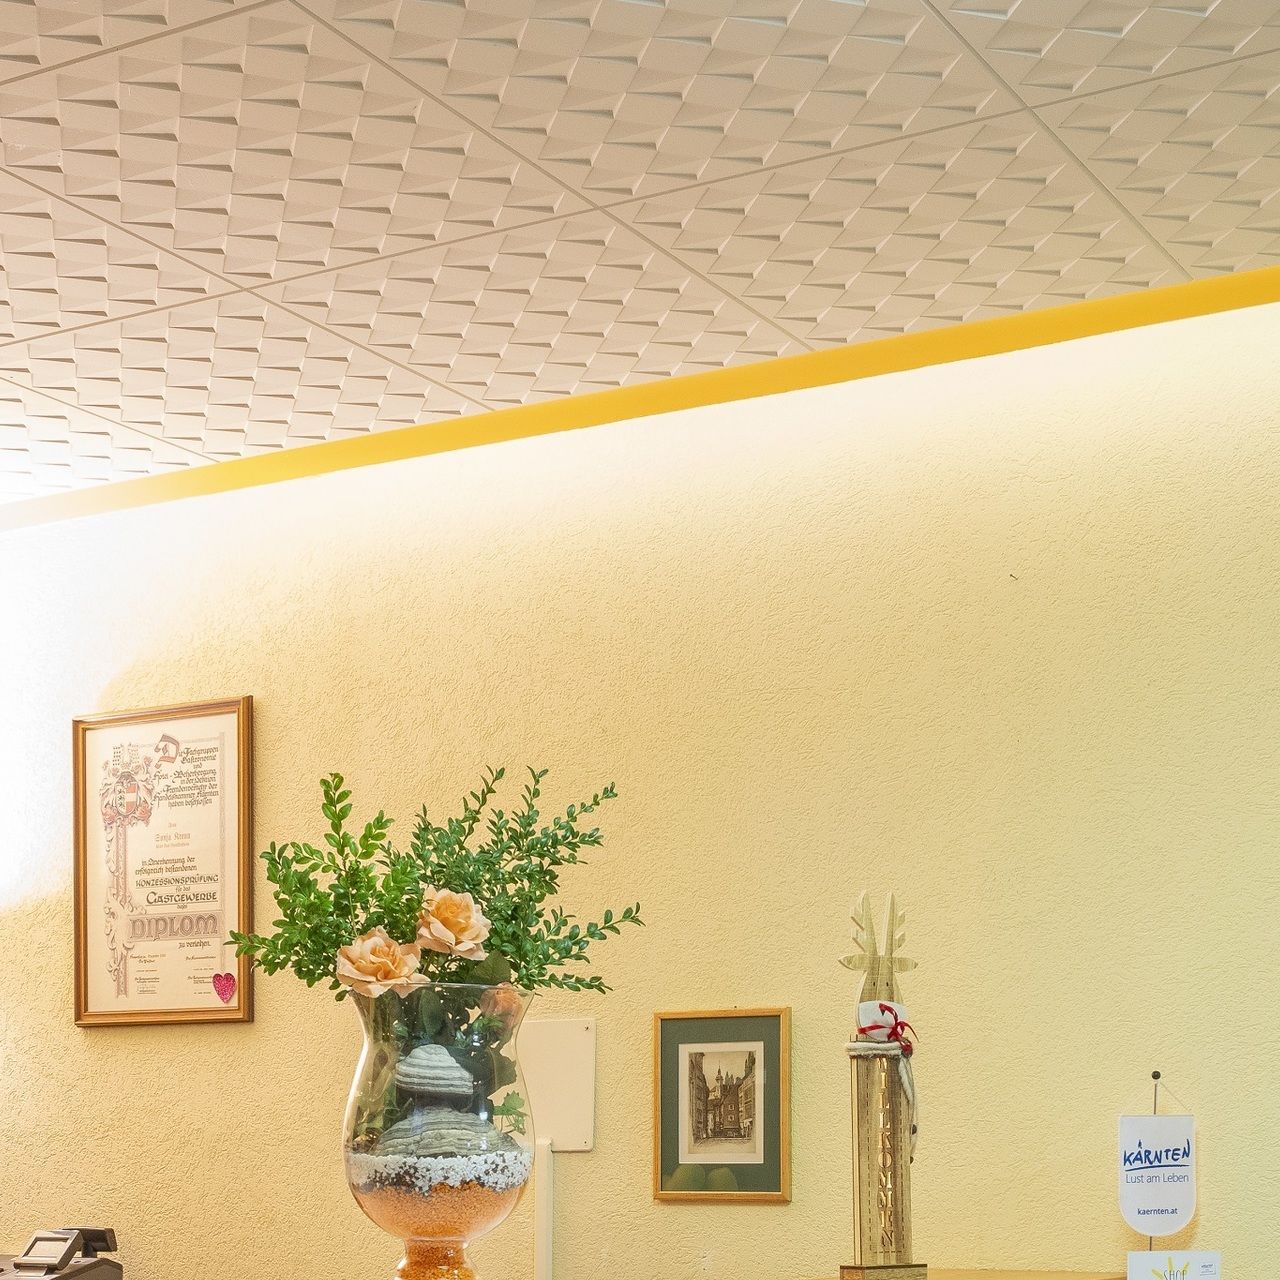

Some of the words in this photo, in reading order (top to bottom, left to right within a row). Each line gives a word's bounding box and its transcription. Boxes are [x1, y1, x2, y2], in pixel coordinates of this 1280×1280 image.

[129, 914, 218, 941] DIPLOM
[1125, 1174, 1145, 1184] Lust
[1146, 1175, 1160, 1183] am
[1162, 1173, 1189, 1183] Leben
[1137, 1207, 1178, 1215] kaernten.at
